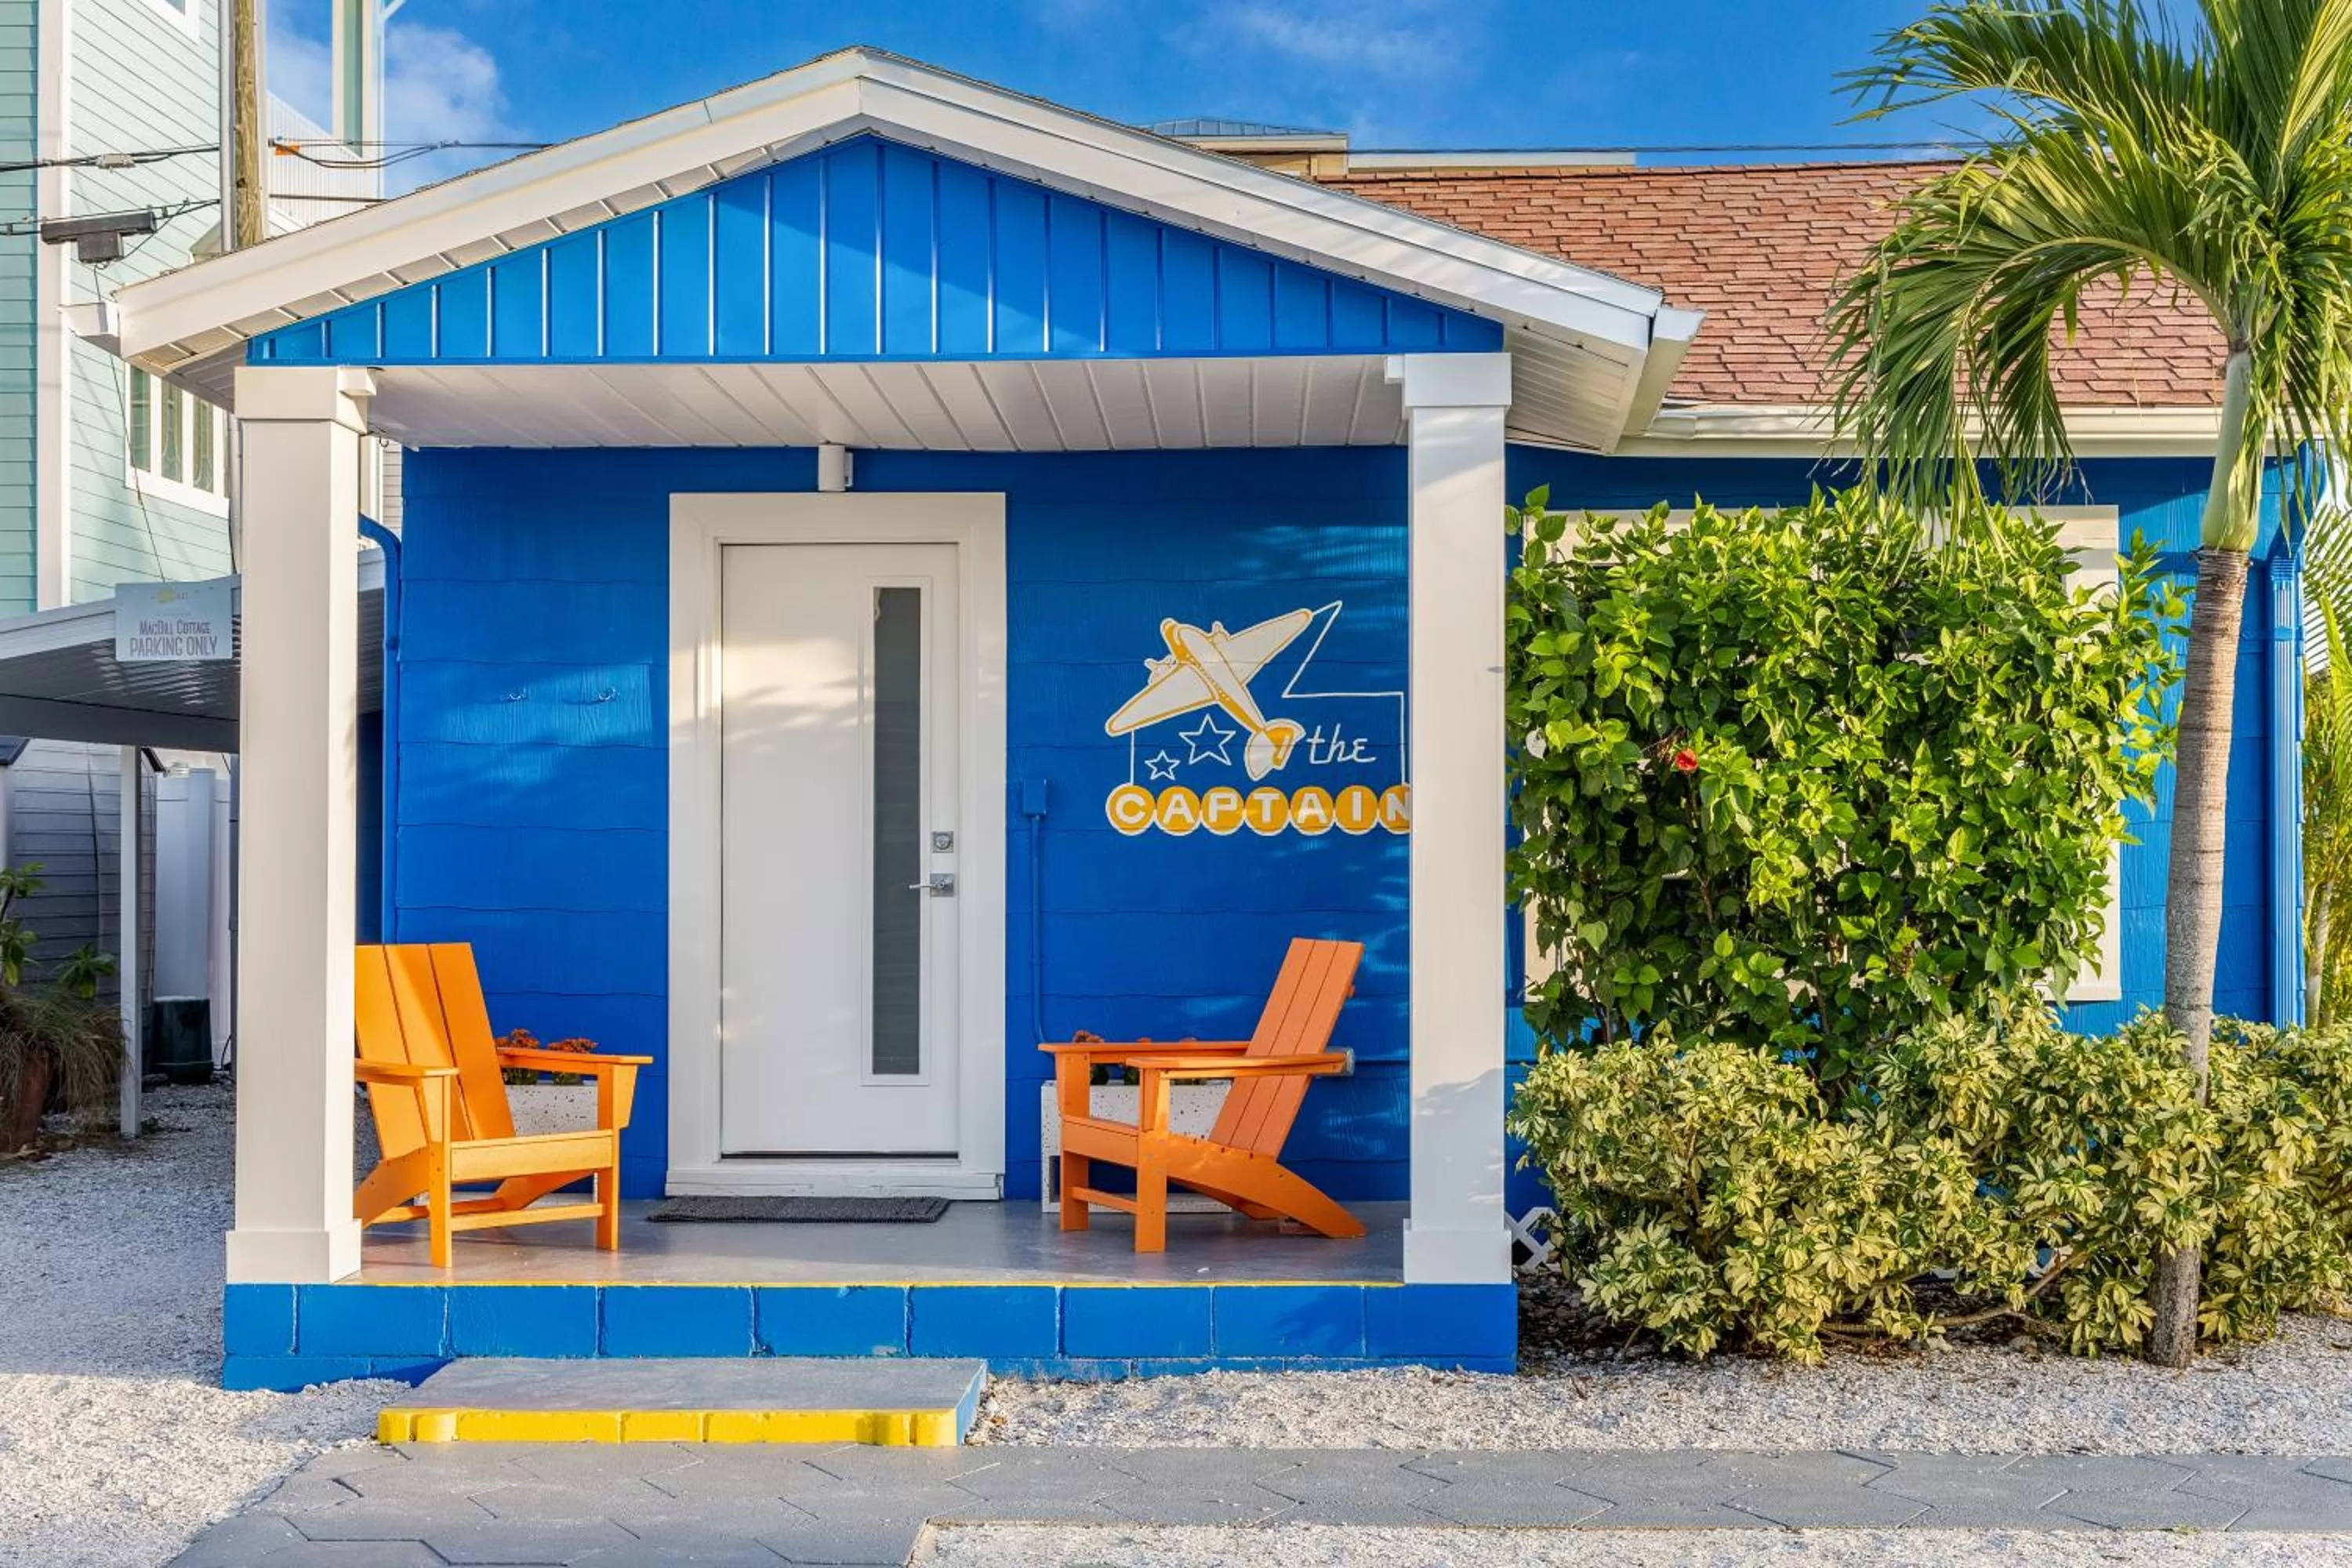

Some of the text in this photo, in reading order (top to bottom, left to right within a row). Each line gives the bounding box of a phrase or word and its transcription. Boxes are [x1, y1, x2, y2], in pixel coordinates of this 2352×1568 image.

[129, 636, 217, 657] PARKING ONLY
[1307, 724, 1377, 764] the
[1116, 791, 1411, 825] CAPTAIN
